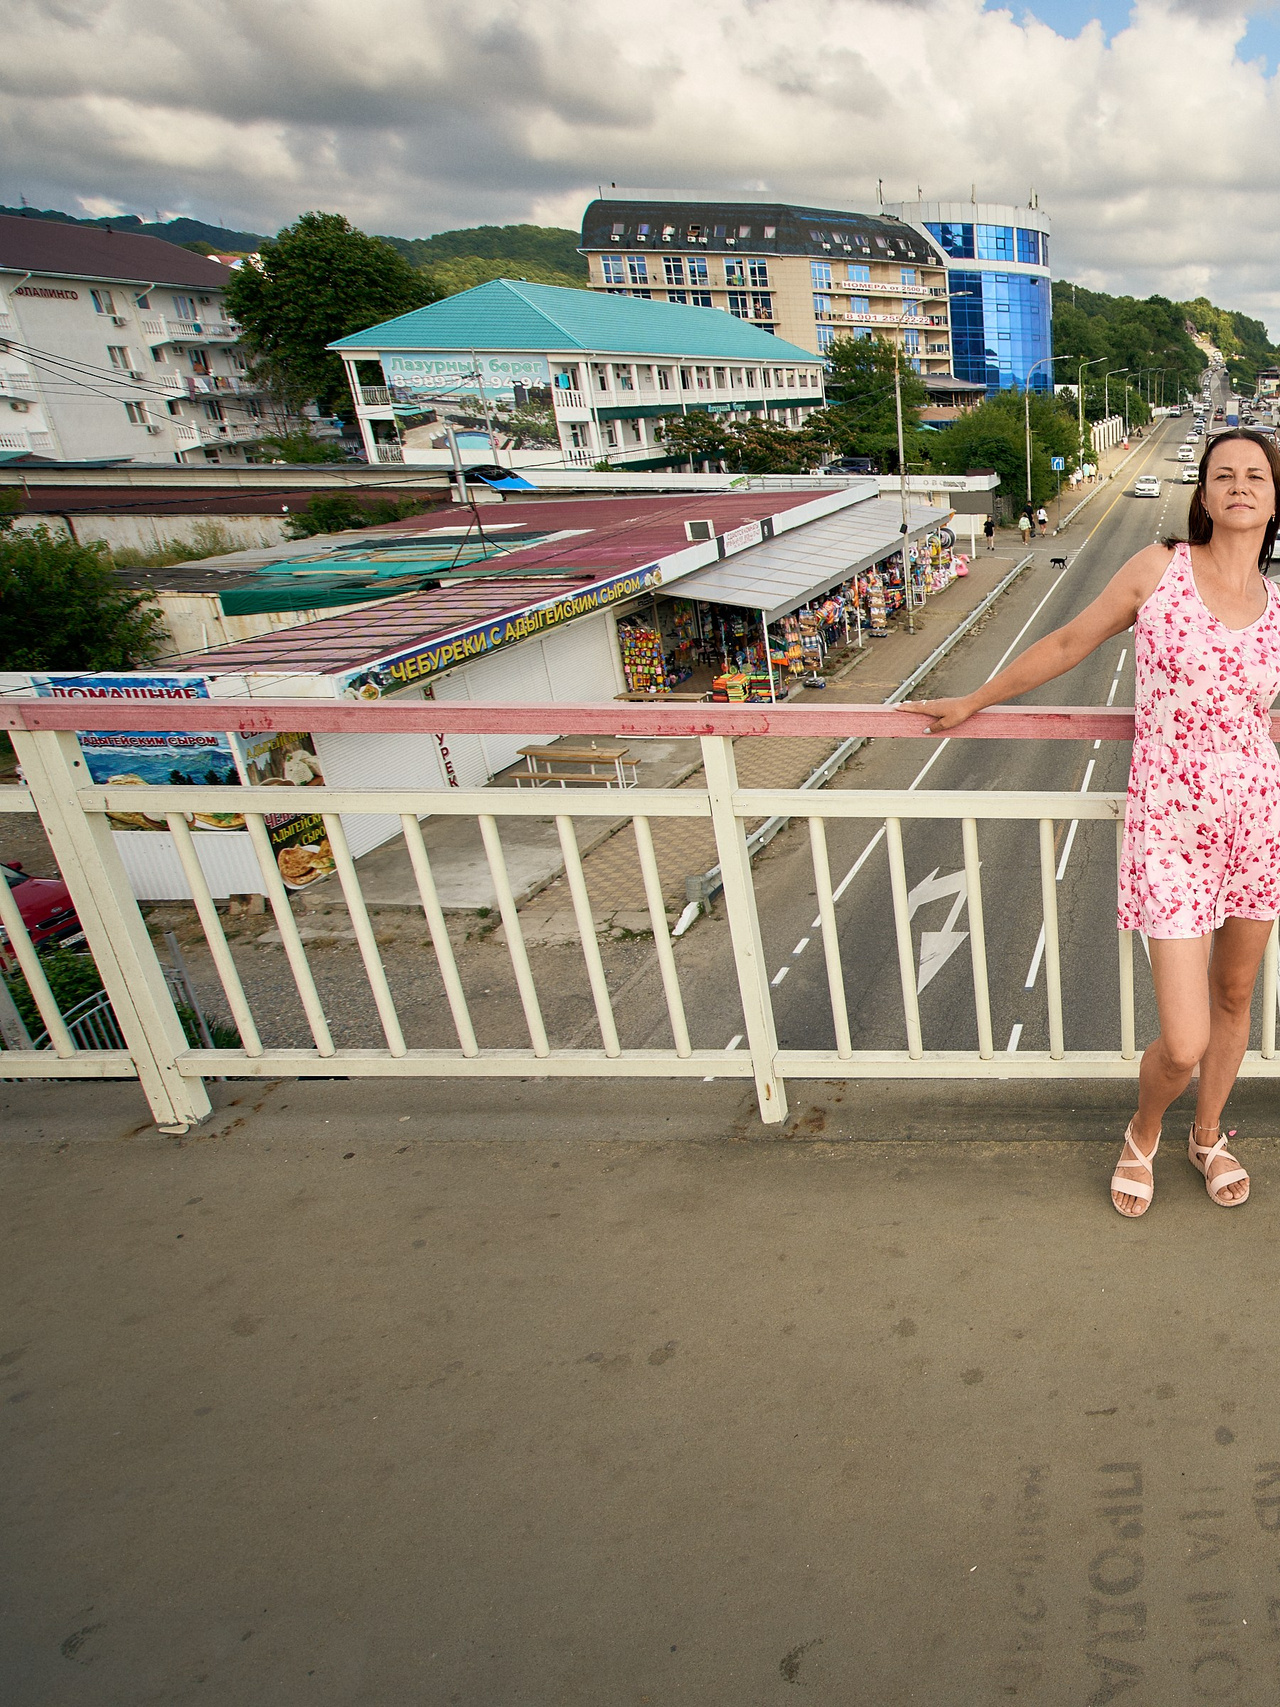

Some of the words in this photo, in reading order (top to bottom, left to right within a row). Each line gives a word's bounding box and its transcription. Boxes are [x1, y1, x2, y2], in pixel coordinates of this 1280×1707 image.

[843, 282, 887, 290] НОМЕРА
[15, 287, 79, 300] ФЛАМИНГО
[391, 357, 485, 375] Лазурный
[488, 358, 543, 376] берег
[390, 632, 488, 684] ЧЕБУРЕКИ
[490, 626, 503, 646] С
[505, 594, 599, 642] АДЫГЕЙСКИМ
[599, 575, 641, 604] СЫРОМ
[83, 735, 167, 747] АДЫГЕЙСКИМ
[168, 736, 217, 747] СЫРОМ
